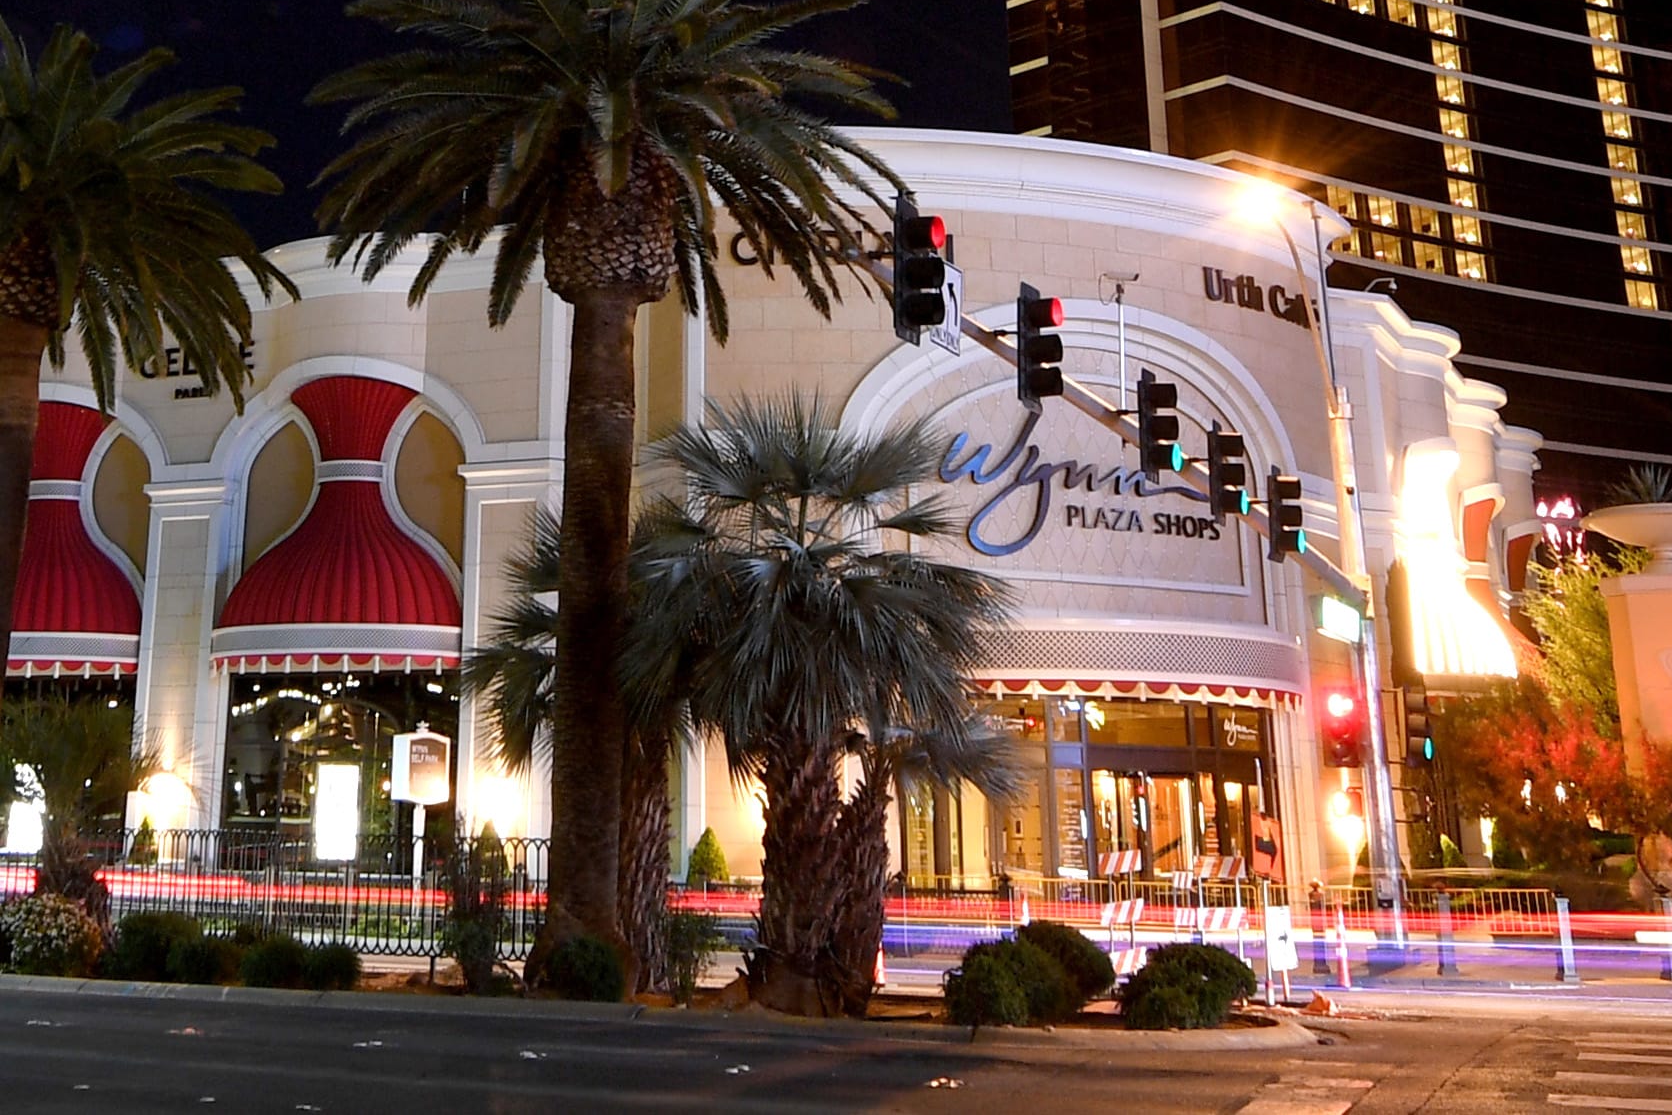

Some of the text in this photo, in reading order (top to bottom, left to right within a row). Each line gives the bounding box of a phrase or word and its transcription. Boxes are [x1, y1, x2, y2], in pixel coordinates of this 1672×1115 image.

[1202, 266, 1265, 312] Urth
[1066, 505, 1221, 541] PLAZA SHOPS
